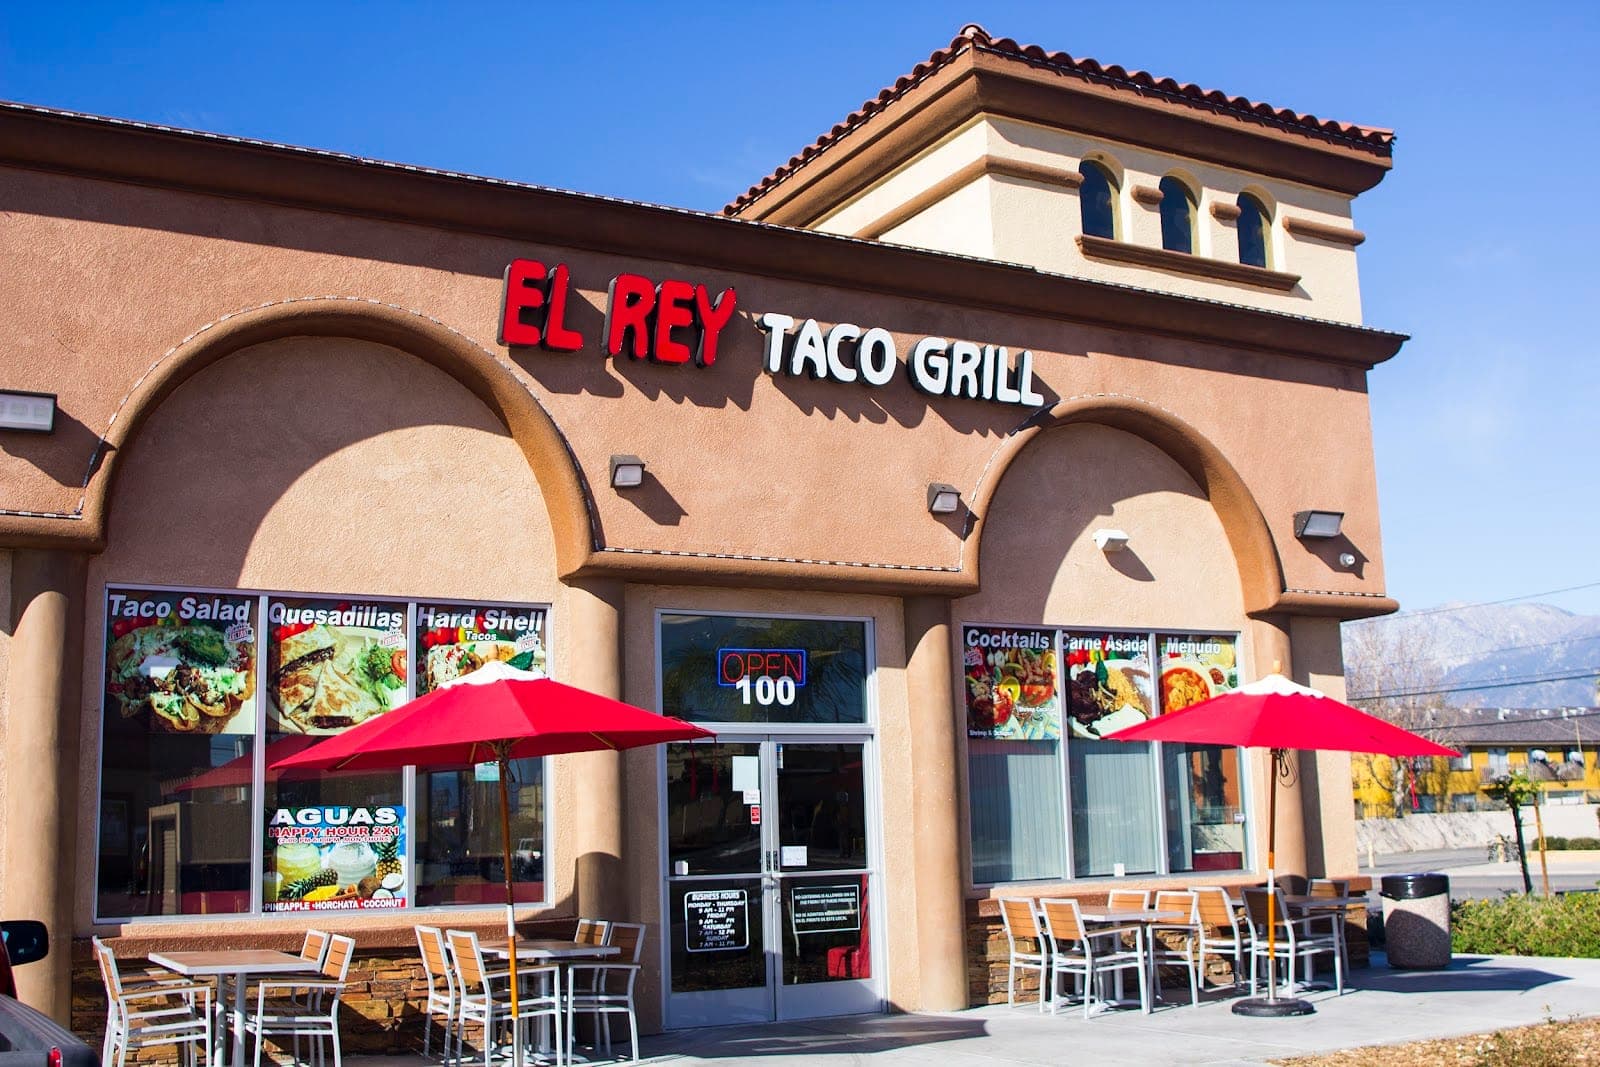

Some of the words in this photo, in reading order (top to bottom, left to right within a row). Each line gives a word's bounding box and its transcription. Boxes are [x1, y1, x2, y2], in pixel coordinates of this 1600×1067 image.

[501, 257, 584, 352] EL
[606, 273, 736, 367] REY
[762, 312, 897, 387] TACO
[910, 336, 1044, 406] GRILL
[109, 594, 171, 618] Taco
[180, 597, 250, 621] Salad
[269, 602, 403, 627] Quesadillas
[417, 606, 477, 629] Hard
[483, 610, 543, 631] Shell
[465, 631, 497, 641] Tacos
[967, 629, 1050, 649] Cocktails
[1062, 633, 1102, 650] Carne
[1105, 635, 1148, 652] Asada
[1167, 637, 1221, 654] Menudo
[722, 653, 802, 683] OPEN
[735, 675, 795, 706] 100
[270, 807, 397, 825] AGUAS
[269, 827, 321, 838] HAPPY
[326, 826, 369, 837] HOUR
[372, 825, 400, 836] 2X1
[264, 902, 310, 911] PINEAPPLE
[314, 900, 358, 910] HORCHATA
[363, 898, 402, 908] COCONUT
